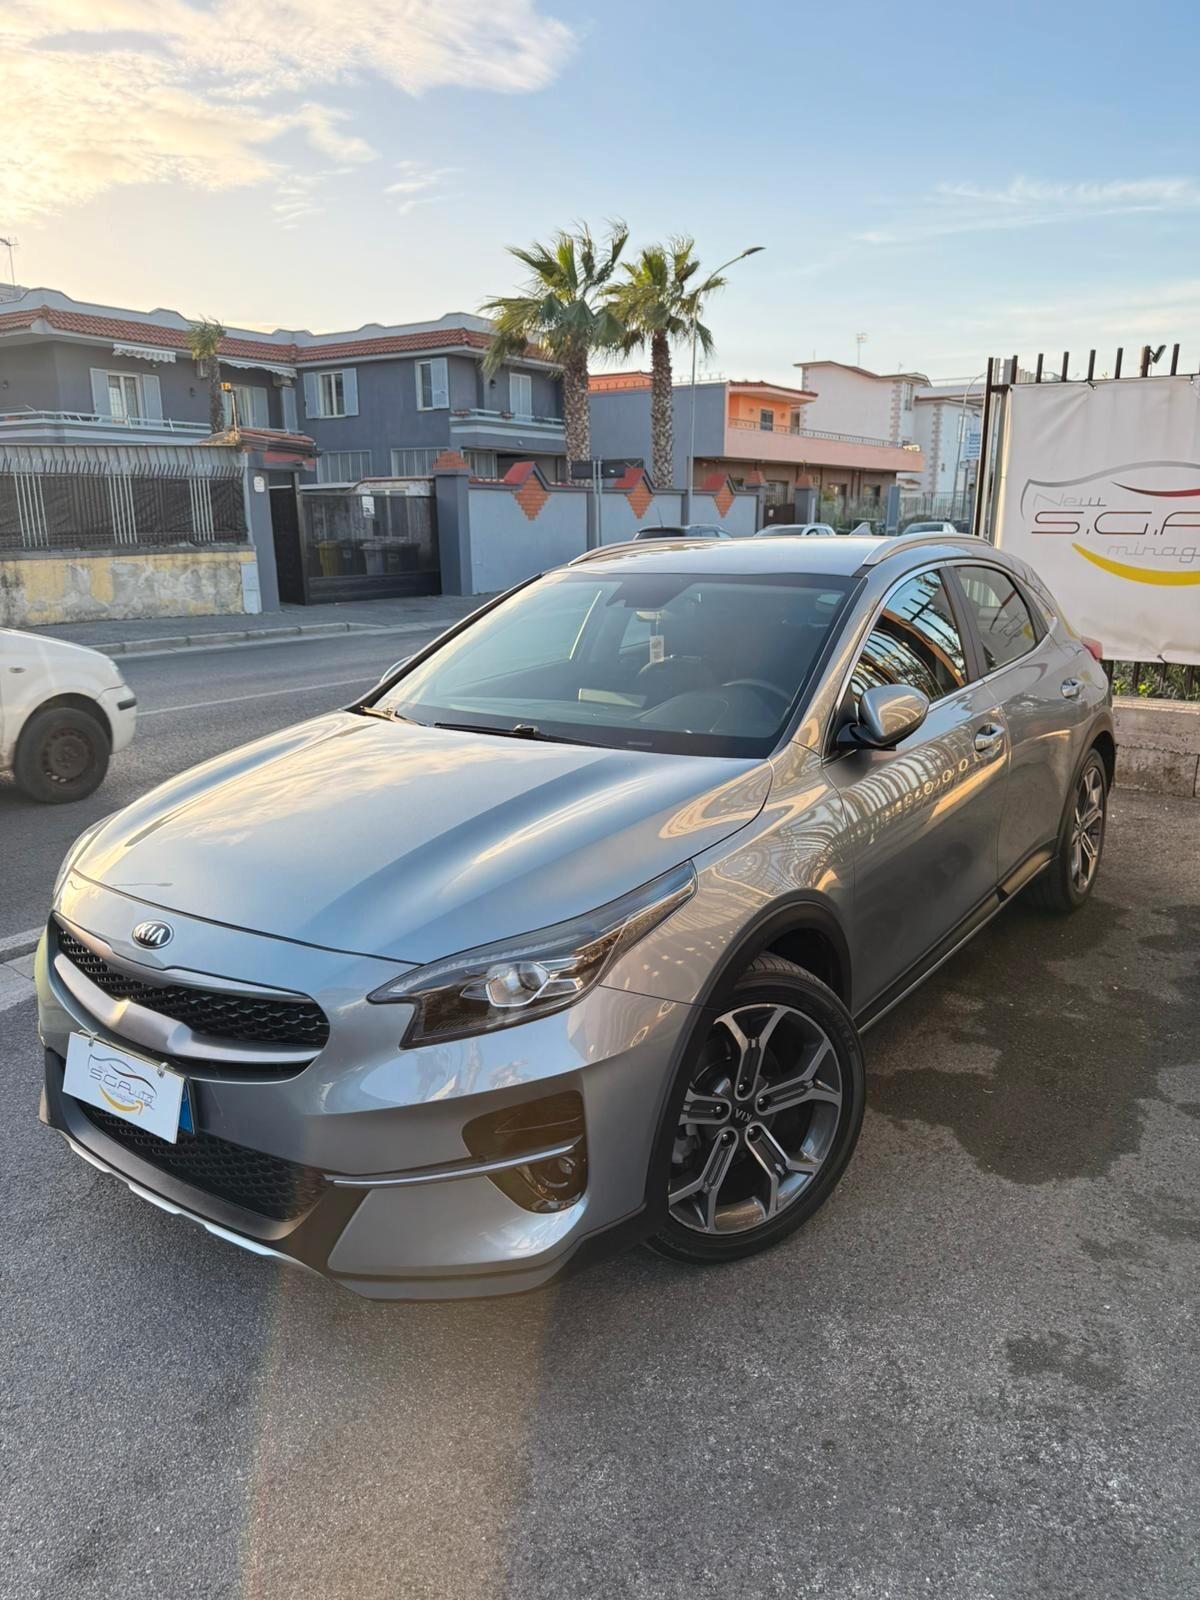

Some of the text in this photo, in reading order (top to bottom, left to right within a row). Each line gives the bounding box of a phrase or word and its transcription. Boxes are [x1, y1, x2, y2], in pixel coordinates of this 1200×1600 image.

[1033, 492, 1107, 508] New
[136, 922, 166, 945] KIA
[735, 1108, 753, 1123] KIA
